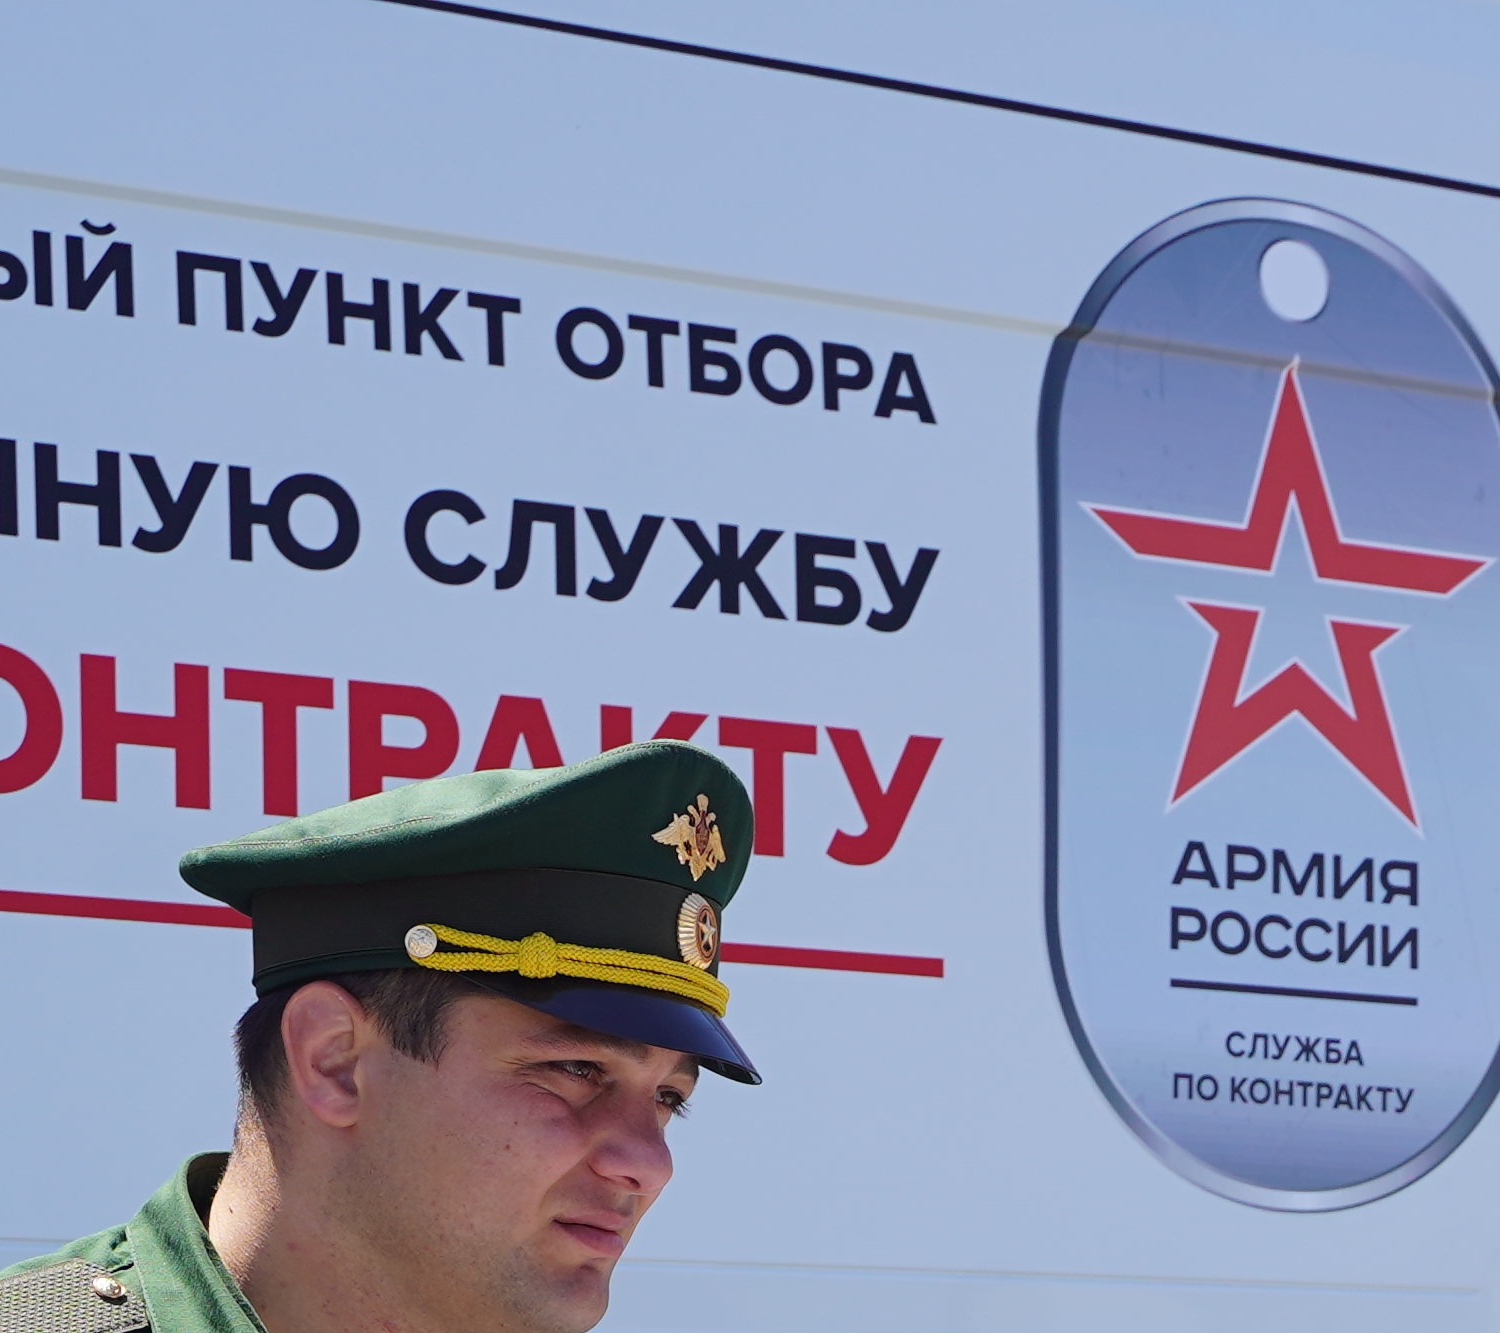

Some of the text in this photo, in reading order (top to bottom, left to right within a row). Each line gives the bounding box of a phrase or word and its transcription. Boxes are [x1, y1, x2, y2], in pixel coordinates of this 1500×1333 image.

[175, 250, 522, 368] ПУНКТ
[554, 306, 939, 425] ОТБОРА
[402, 488, 941, 633] СЛУЖБУ
[1171, 840, 1420, 907] АРМИЯ
[1170, 906, 1419, 970] РОССИИ
[1225, 1031, 1365, 1067] СЛУЖБА
[1173, 1073, 1414, 1114] ПО КОНТРАКТУ
